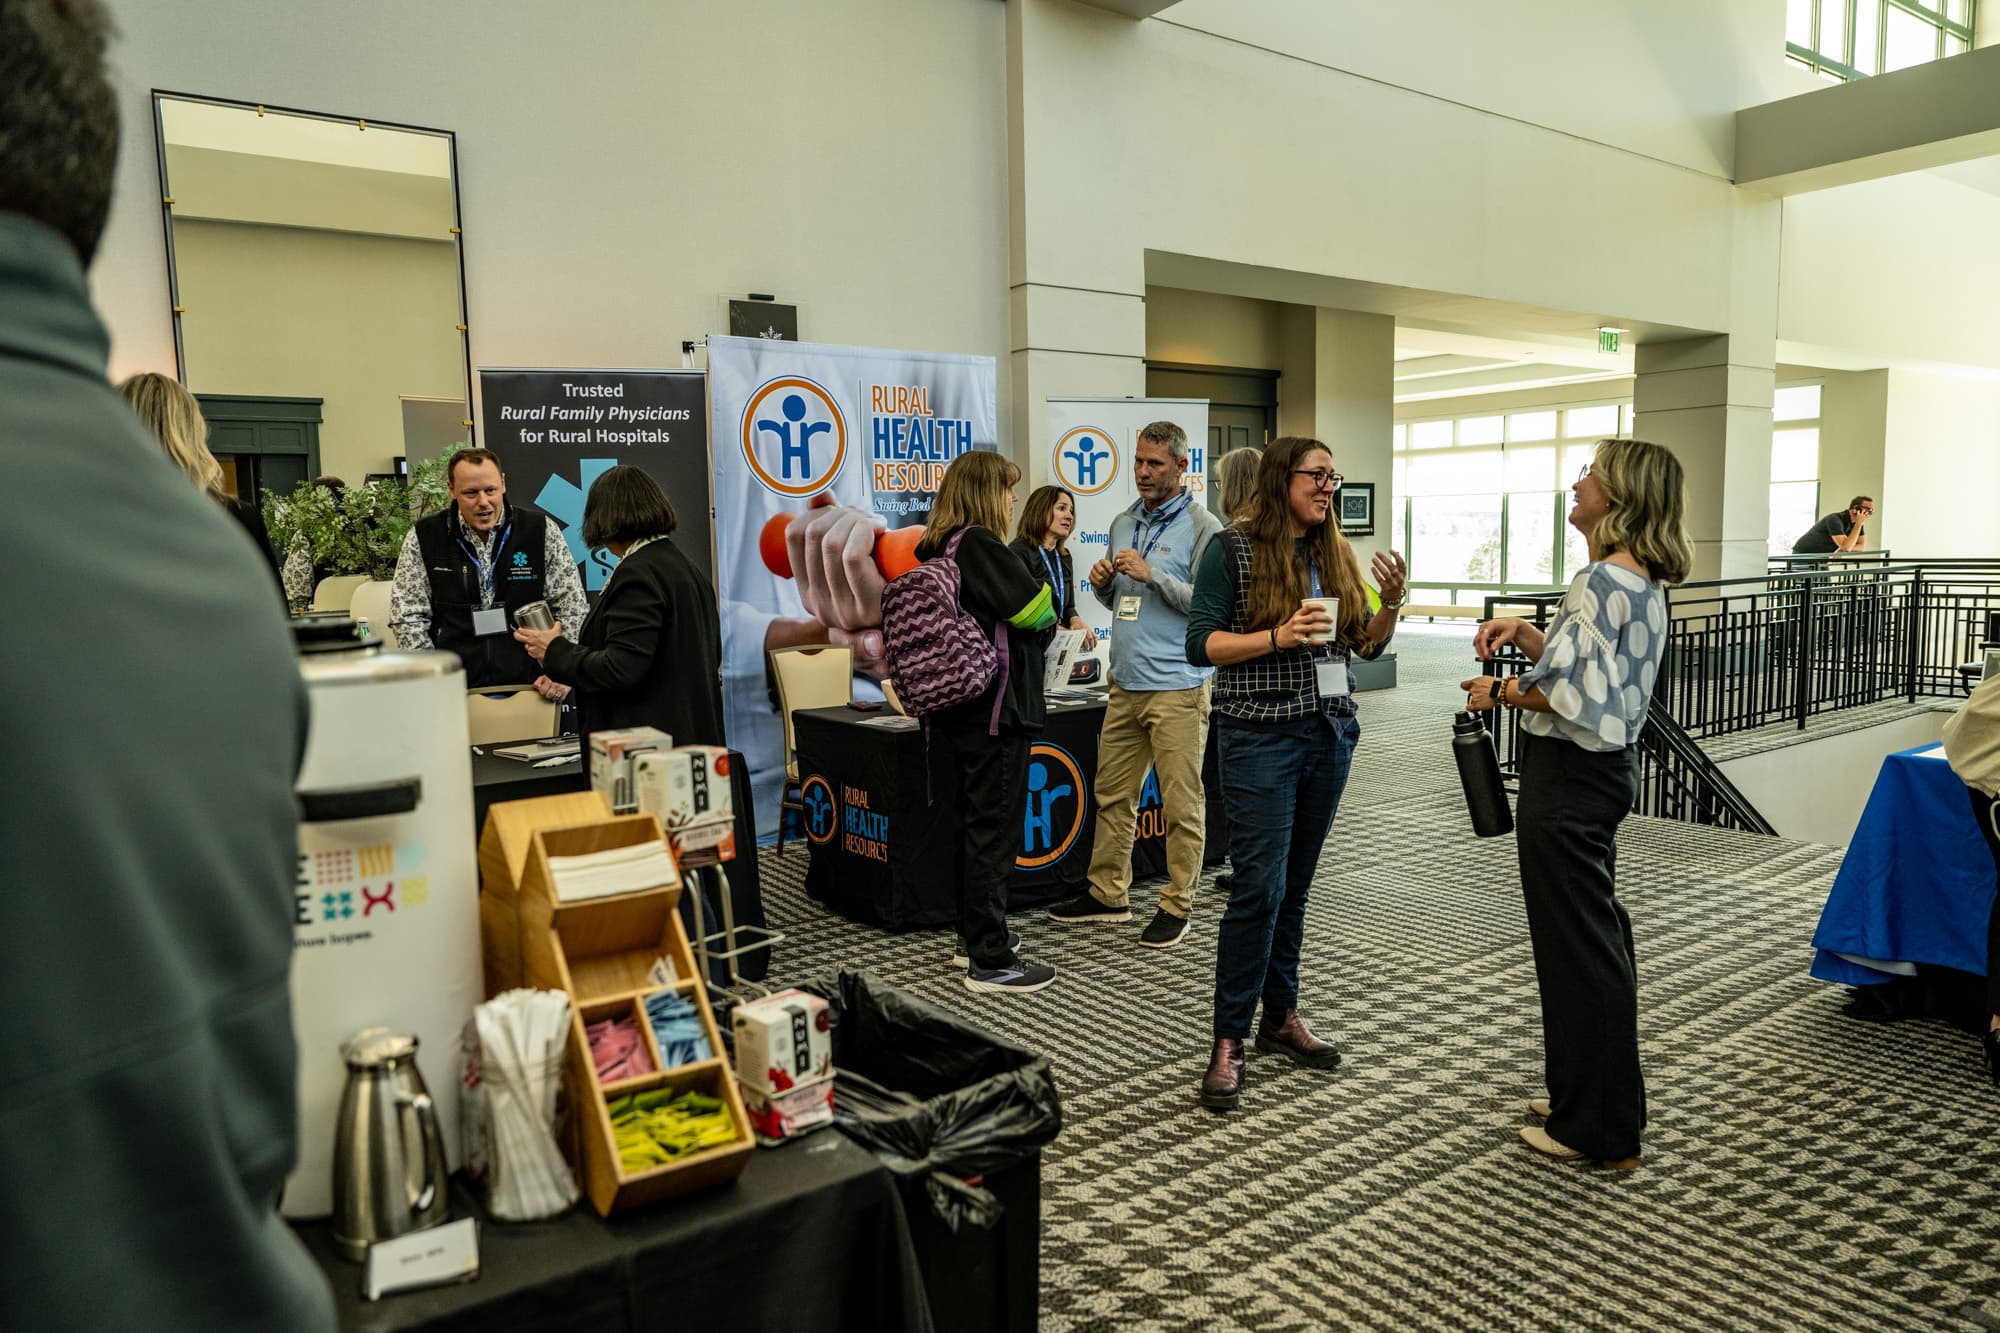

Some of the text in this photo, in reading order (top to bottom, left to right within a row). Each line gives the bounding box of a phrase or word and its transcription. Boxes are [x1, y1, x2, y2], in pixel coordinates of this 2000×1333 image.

[562, 383, 624, 398] Trusted
[872, 385, 933, 415] RURAL
[501, 405, 690, 423] Rural Family Physicians
[520, 429, 670, 446] for Rural Hospitals
[872, 417, 972, 460] HEALTH
[873, 463, 948, 492] RESOUR
[874, 498, 908, 515] Swing
[910, 498, 932, 512] Bed
[1080, 531, 1109, 546] Swing
[845, 786, 870, 809] RURAL
[845, 805, 889, 843] HEALTH
